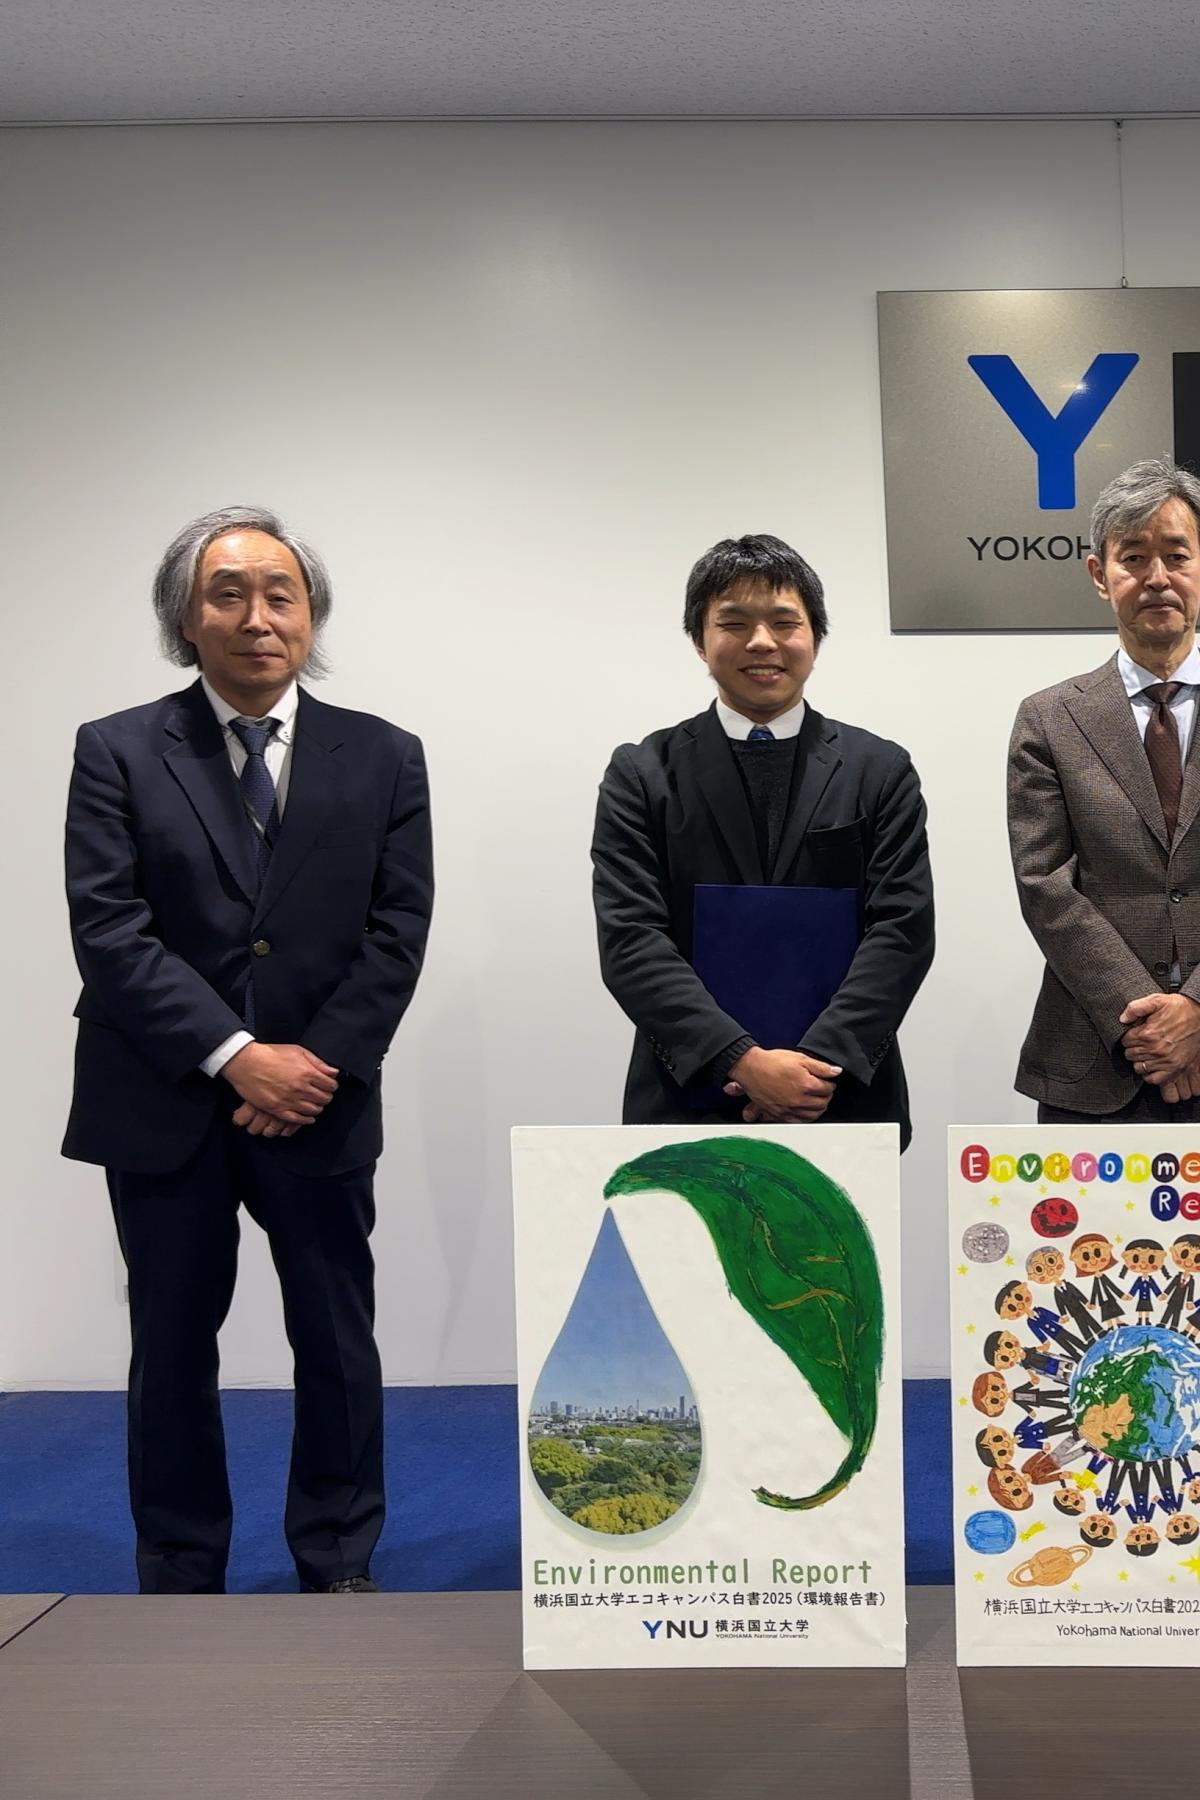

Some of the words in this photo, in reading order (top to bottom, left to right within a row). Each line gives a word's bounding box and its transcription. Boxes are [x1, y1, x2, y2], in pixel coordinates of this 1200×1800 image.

[967, 535, 1092, 561] YOKOH
[533, 1558, 749, 1585] Environmental
[772, 1558, 872, 1587] Report
[642, 1620, 708, 1639] YNU
[715, 1619, 809, 1632] 横浜国立大学
[1119, 1625, 1162, 1636] National
